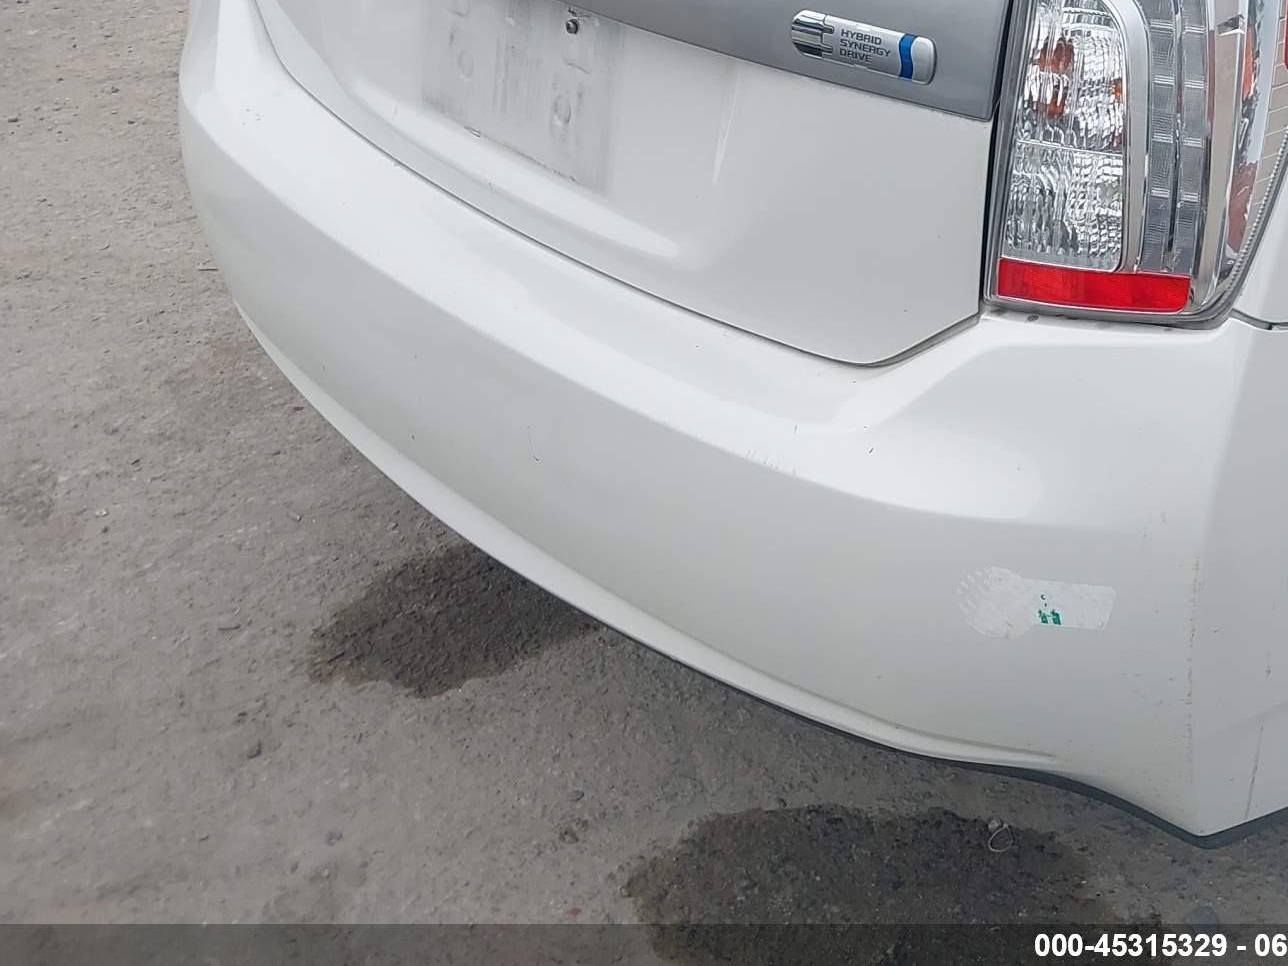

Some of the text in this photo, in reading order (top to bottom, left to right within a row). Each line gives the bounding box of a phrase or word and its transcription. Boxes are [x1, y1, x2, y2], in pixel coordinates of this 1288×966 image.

[841, 29, 882, 45] HYBRID
[839, 48, 872, 63] DRIVE
[840, 38, 891, 57] SYNERGY
